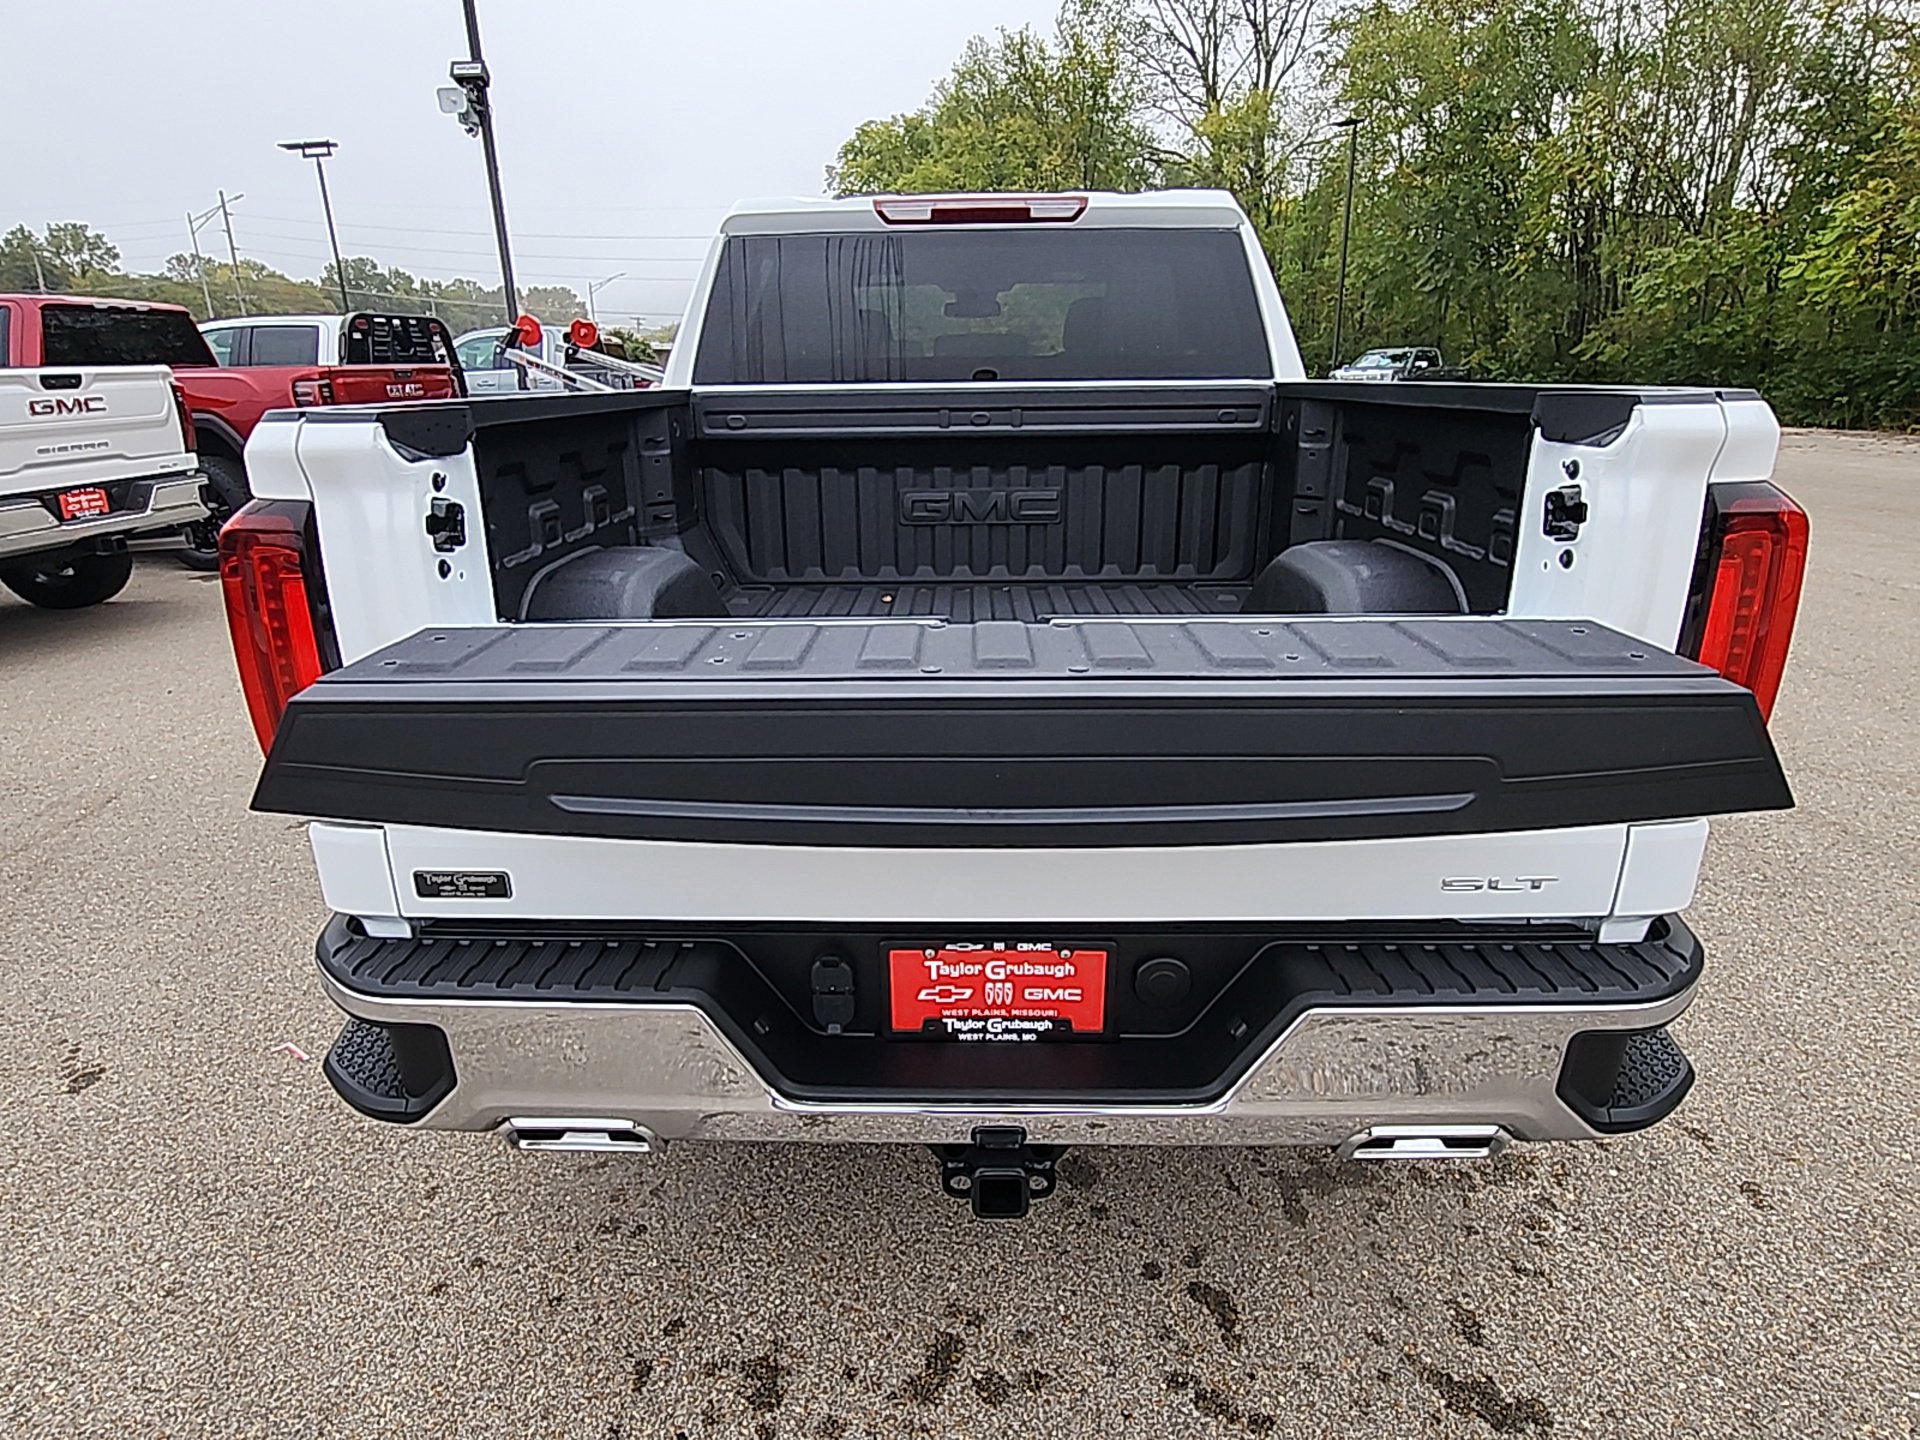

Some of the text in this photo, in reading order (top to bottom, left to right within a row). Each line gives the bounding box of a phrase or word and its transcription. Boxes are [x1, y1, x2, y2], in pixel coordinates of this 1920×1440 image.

[29, 397, 107, 416] GMC
[37, 441, 109, 454] SIERRA
[903, 491, 1059, 521] GMC
[1441, 876, 1559, 892] SLT
[1016, 942, 1052, 951] GMC
[924, 960, 1076, 981] Taylor Grubaugh
[1024, 988, 1083, 1001] GMC
[971, 1009, 1010, 1017] PLAINS,
[1011, 1009, 1058, 1017] MISSOURI
[941, 1018, 1053, 1032] Taylor Grubaugh
[958, 1033, 984, 1041] WEST
[1021, 1033, 1038, 1041] MO
